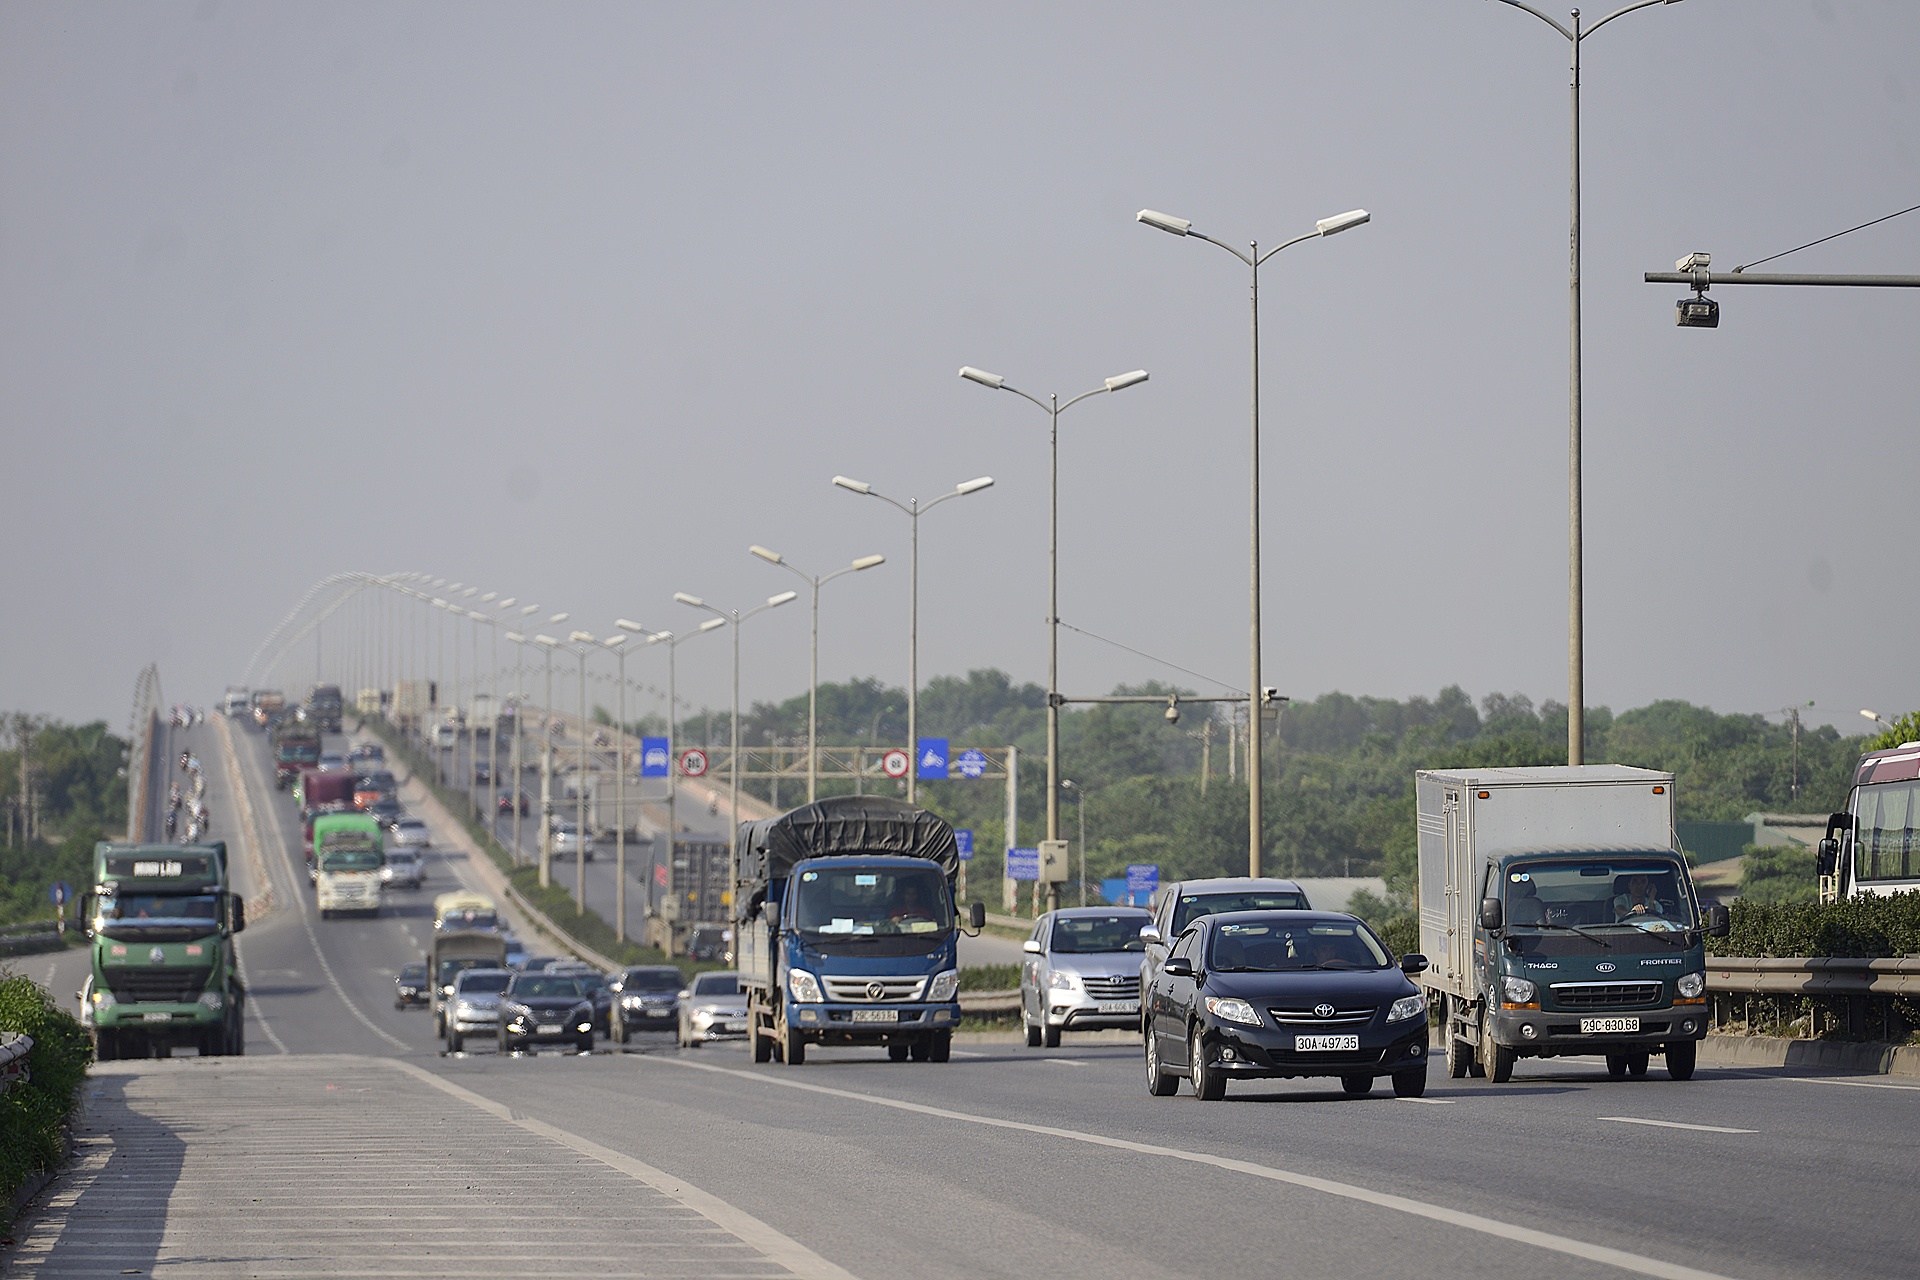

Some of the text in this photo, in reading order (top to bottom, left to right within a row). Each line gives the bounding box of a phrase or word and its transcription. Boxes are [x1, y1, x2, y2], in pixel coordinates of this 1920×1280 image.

[1640, 958, 1683, 966] FRONTIER
[1583, 1019, 1638, 1031] 29C-830.68
[1297, 1037, 1358, 1050] 30A-497.35
